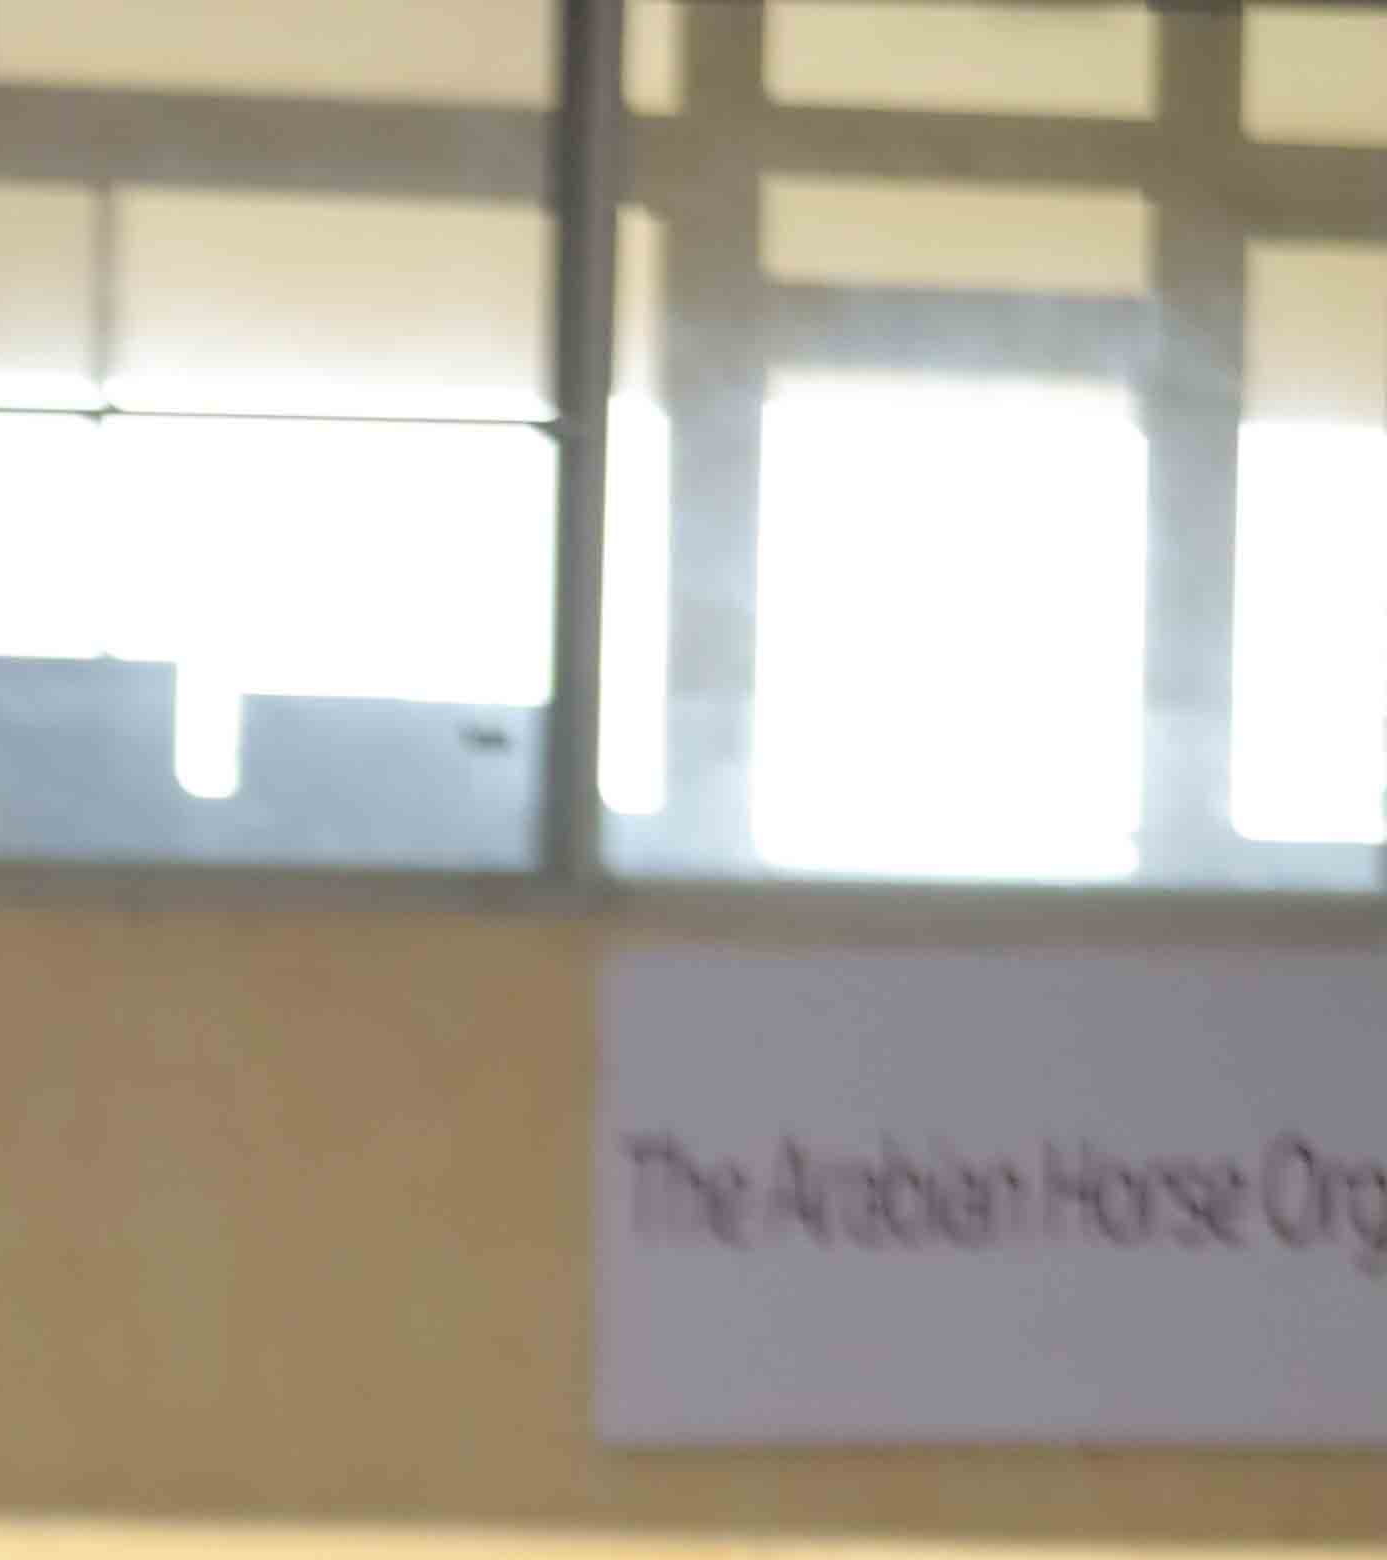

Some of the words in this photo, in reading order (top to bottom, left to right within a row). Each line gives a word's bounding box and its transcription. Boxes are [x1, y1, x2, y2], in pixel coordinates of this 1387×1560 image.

[620, 1130, 751, 1248] The
[771, 1132, 1027, 1250] Arabian
[1039, 1134, 1245, 1250] Horse
